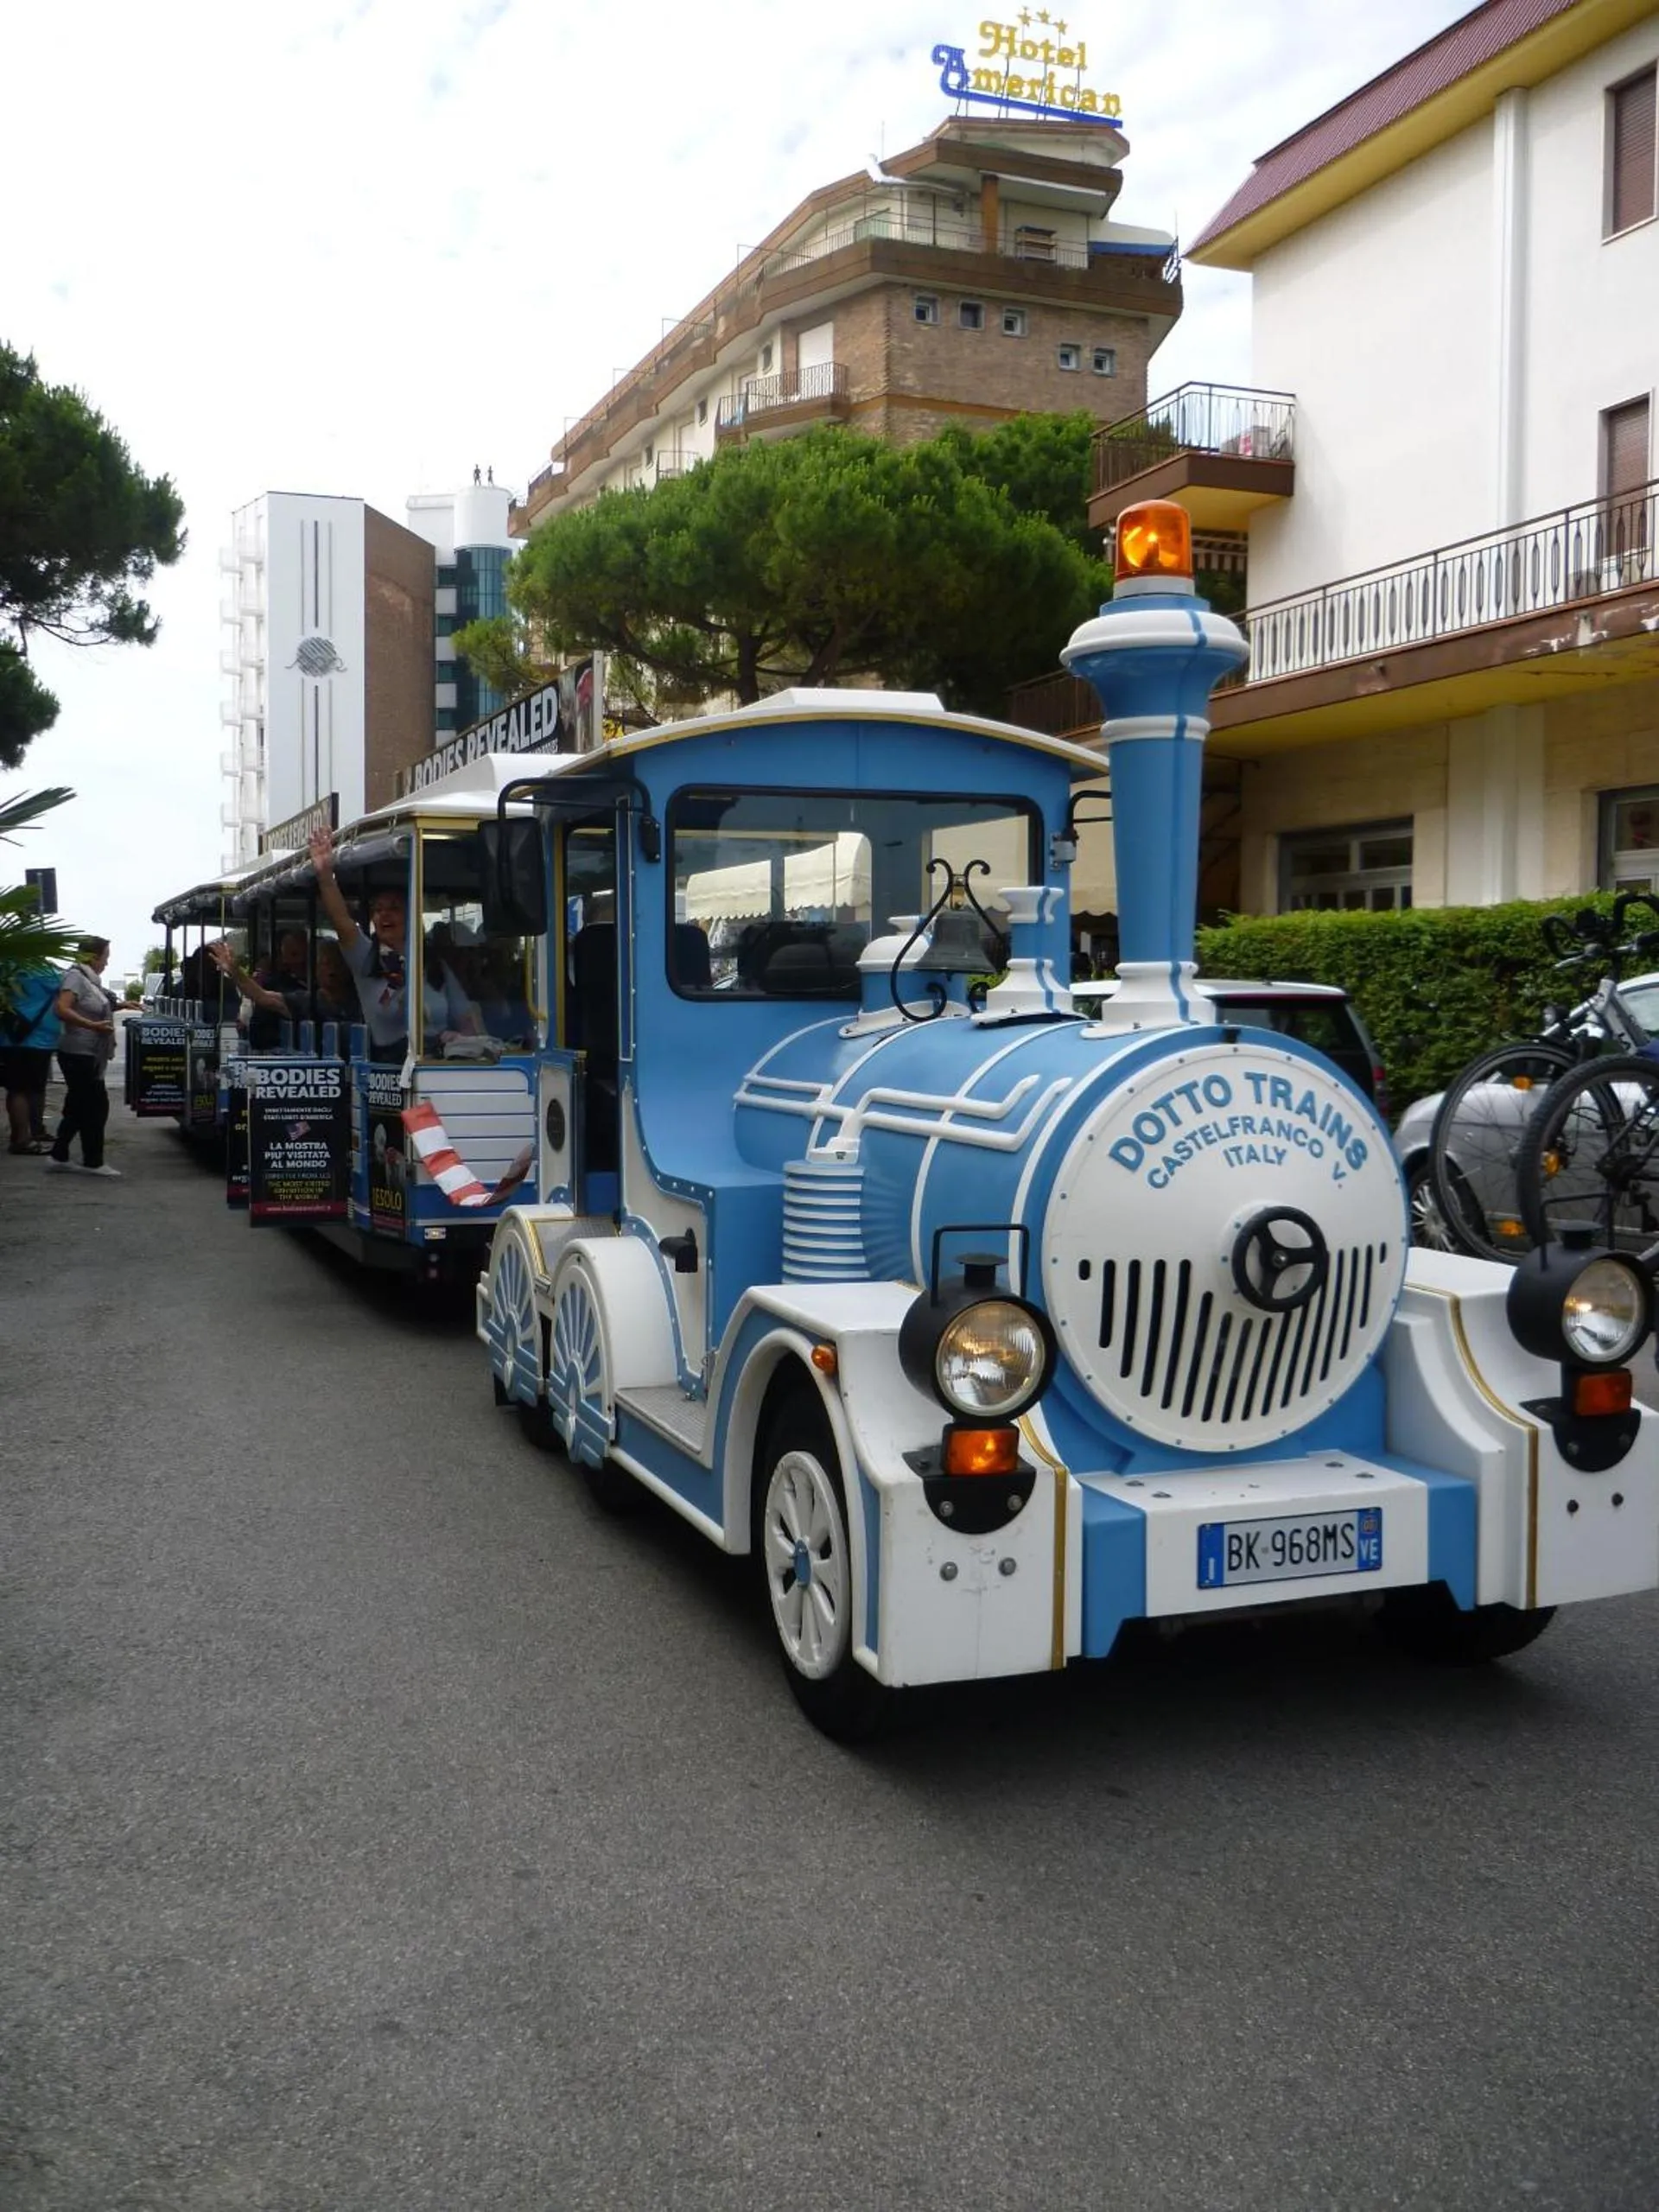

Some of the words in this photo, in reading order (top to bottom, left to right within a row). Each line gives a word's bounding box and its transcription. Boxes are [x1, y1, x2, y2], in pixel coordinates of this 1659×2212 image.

[978, 20, 1088, 71] Hotel
[931, 44, 1122, 128] American
[415, 738, 464, 791] BODIES
[467, 686, 558, 766] REVEALED
[256, 1068, 340, 1085] BODIES
[256, 1086, 341, 1099] REVEALED
[1108, 1074, 1232, 1173] DOTTO
[1244, 1071, 1368, 1171] TRAINS
[285, 1141, 327, 1150] MOSTRA
[1147, 1116, 1325, 1189] CASTELFRANCO
[1223, 1144, 1287, 1167] ITALY
[1359, 1538, 1378, 1560] VE
